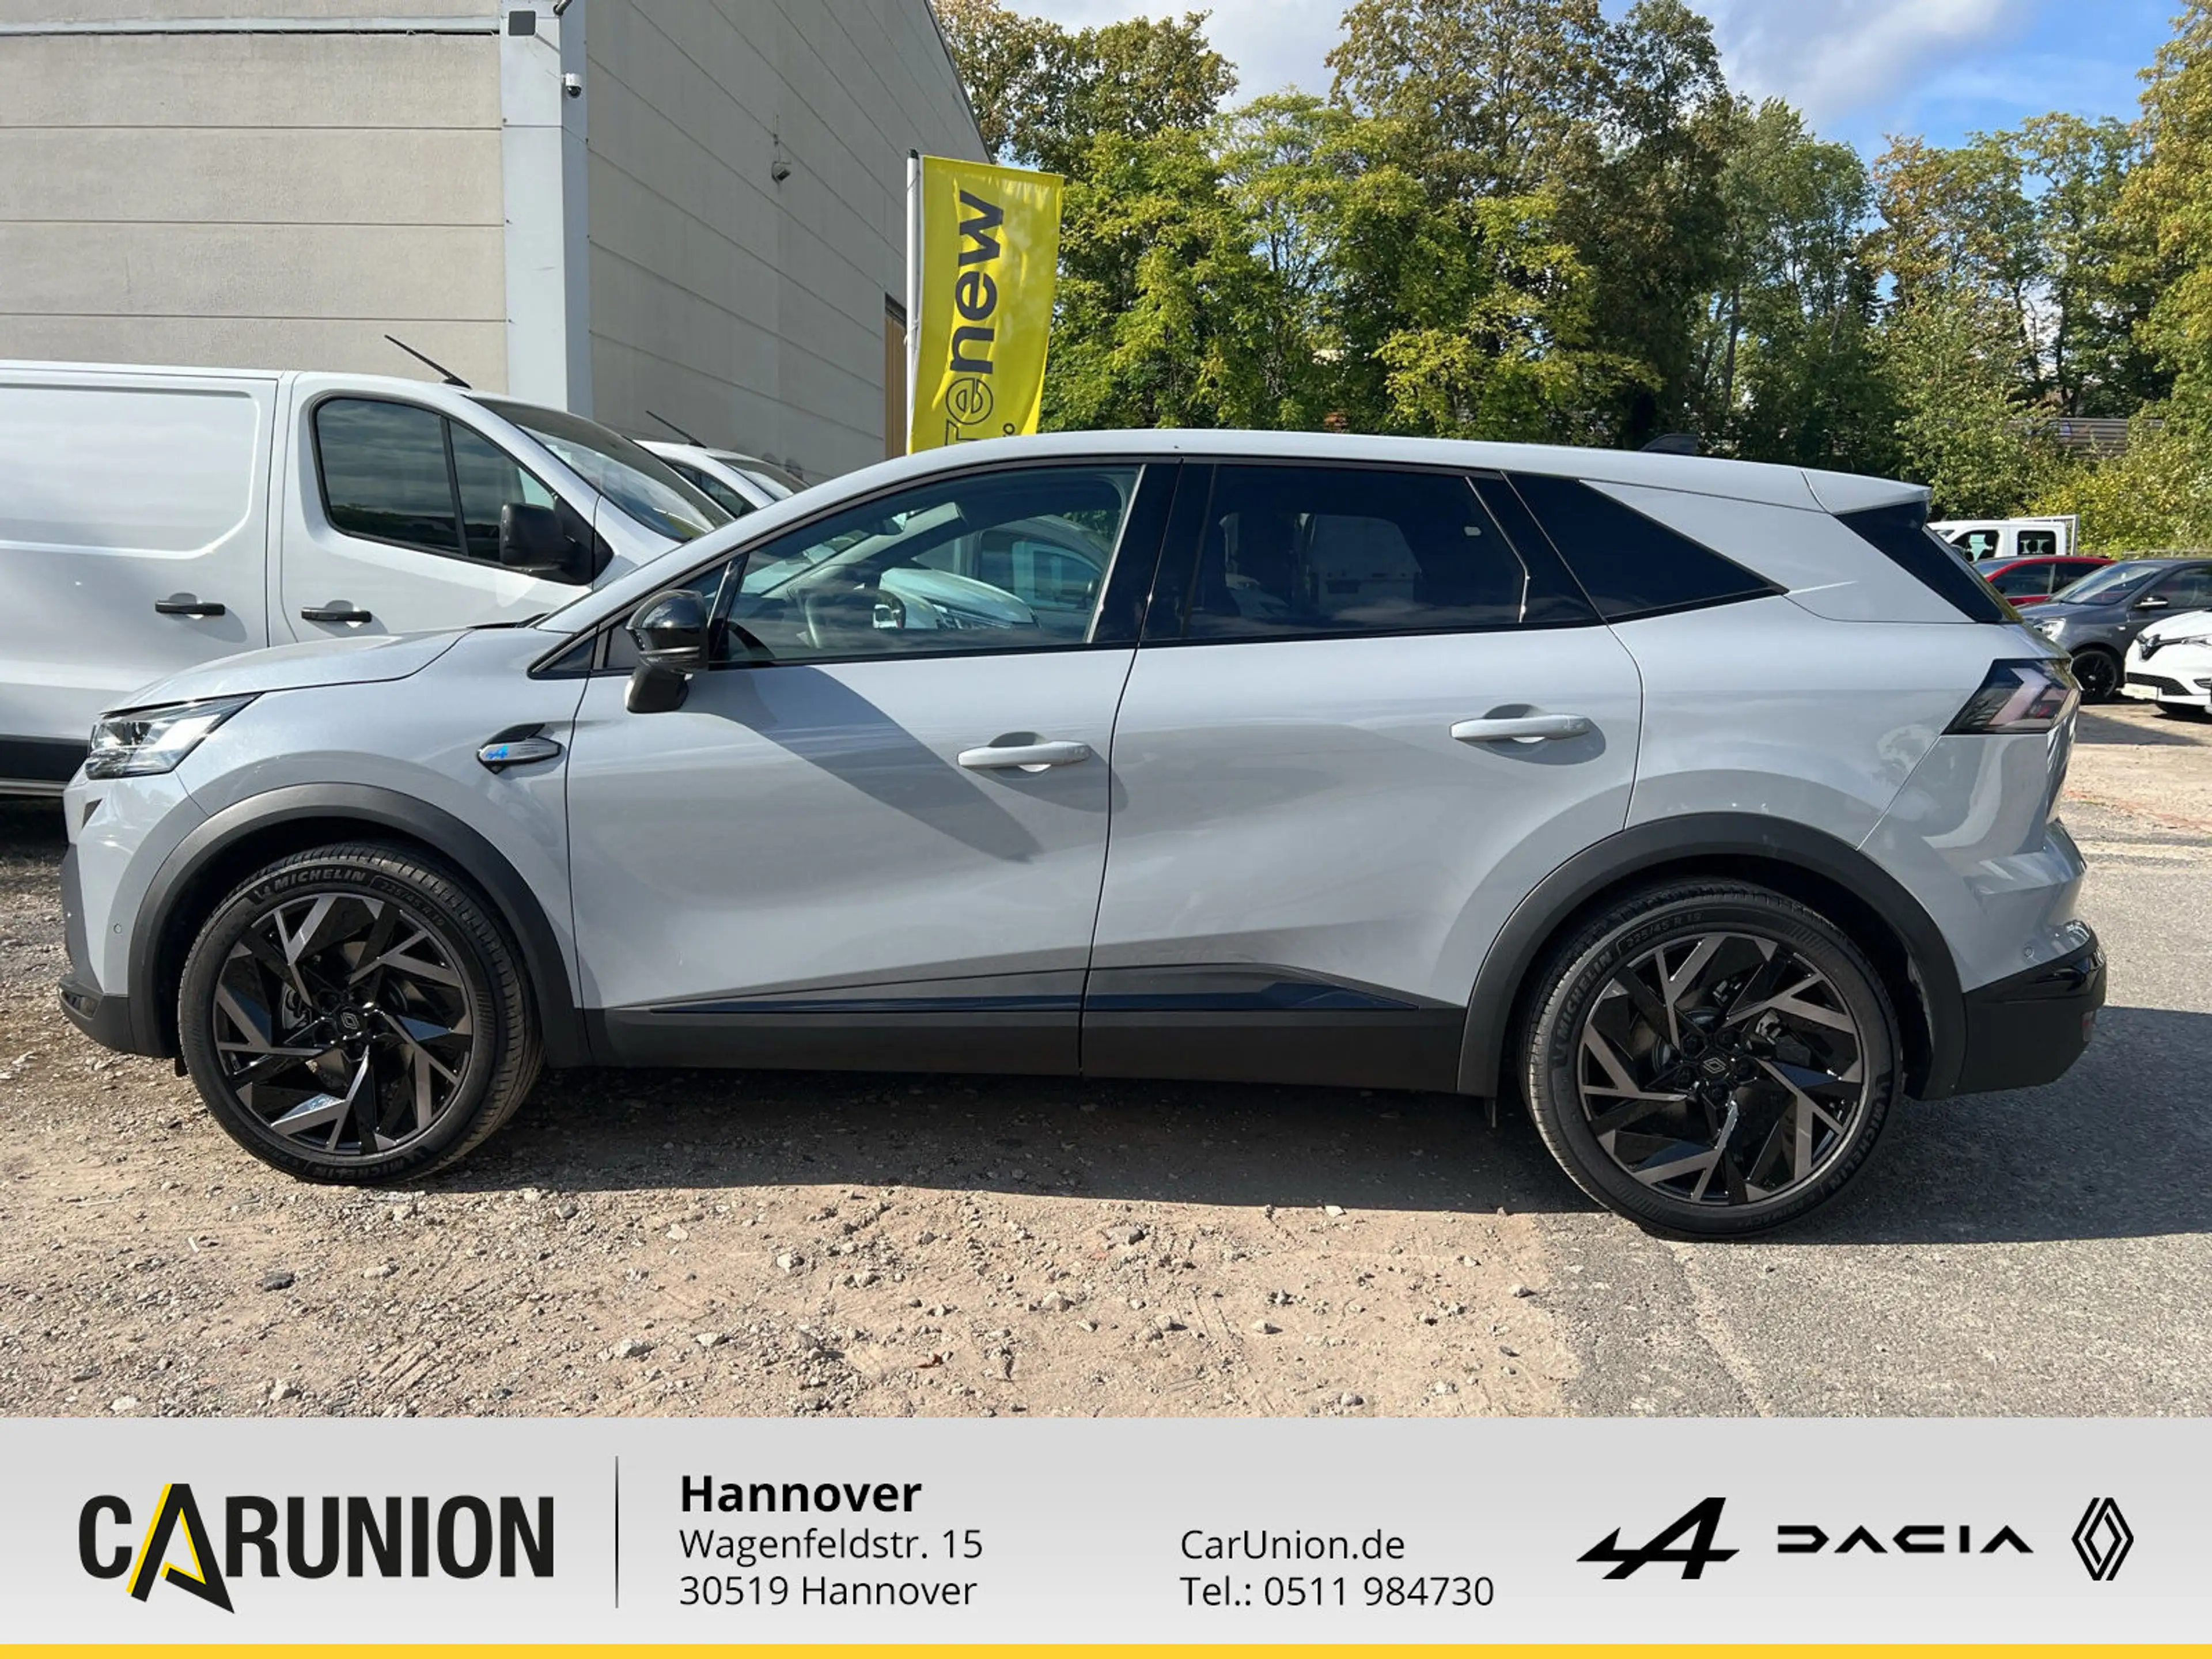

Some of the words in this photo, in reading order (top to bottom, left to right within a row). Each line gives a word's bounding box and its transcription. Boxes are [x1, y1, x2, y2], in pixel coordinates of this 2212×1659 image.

[274, 868, 367, 891] MICHELIN
[1556, 951, 1613, 1040] MICHELIN
[1828, 1101, 1885, 1190] MICHELIN
